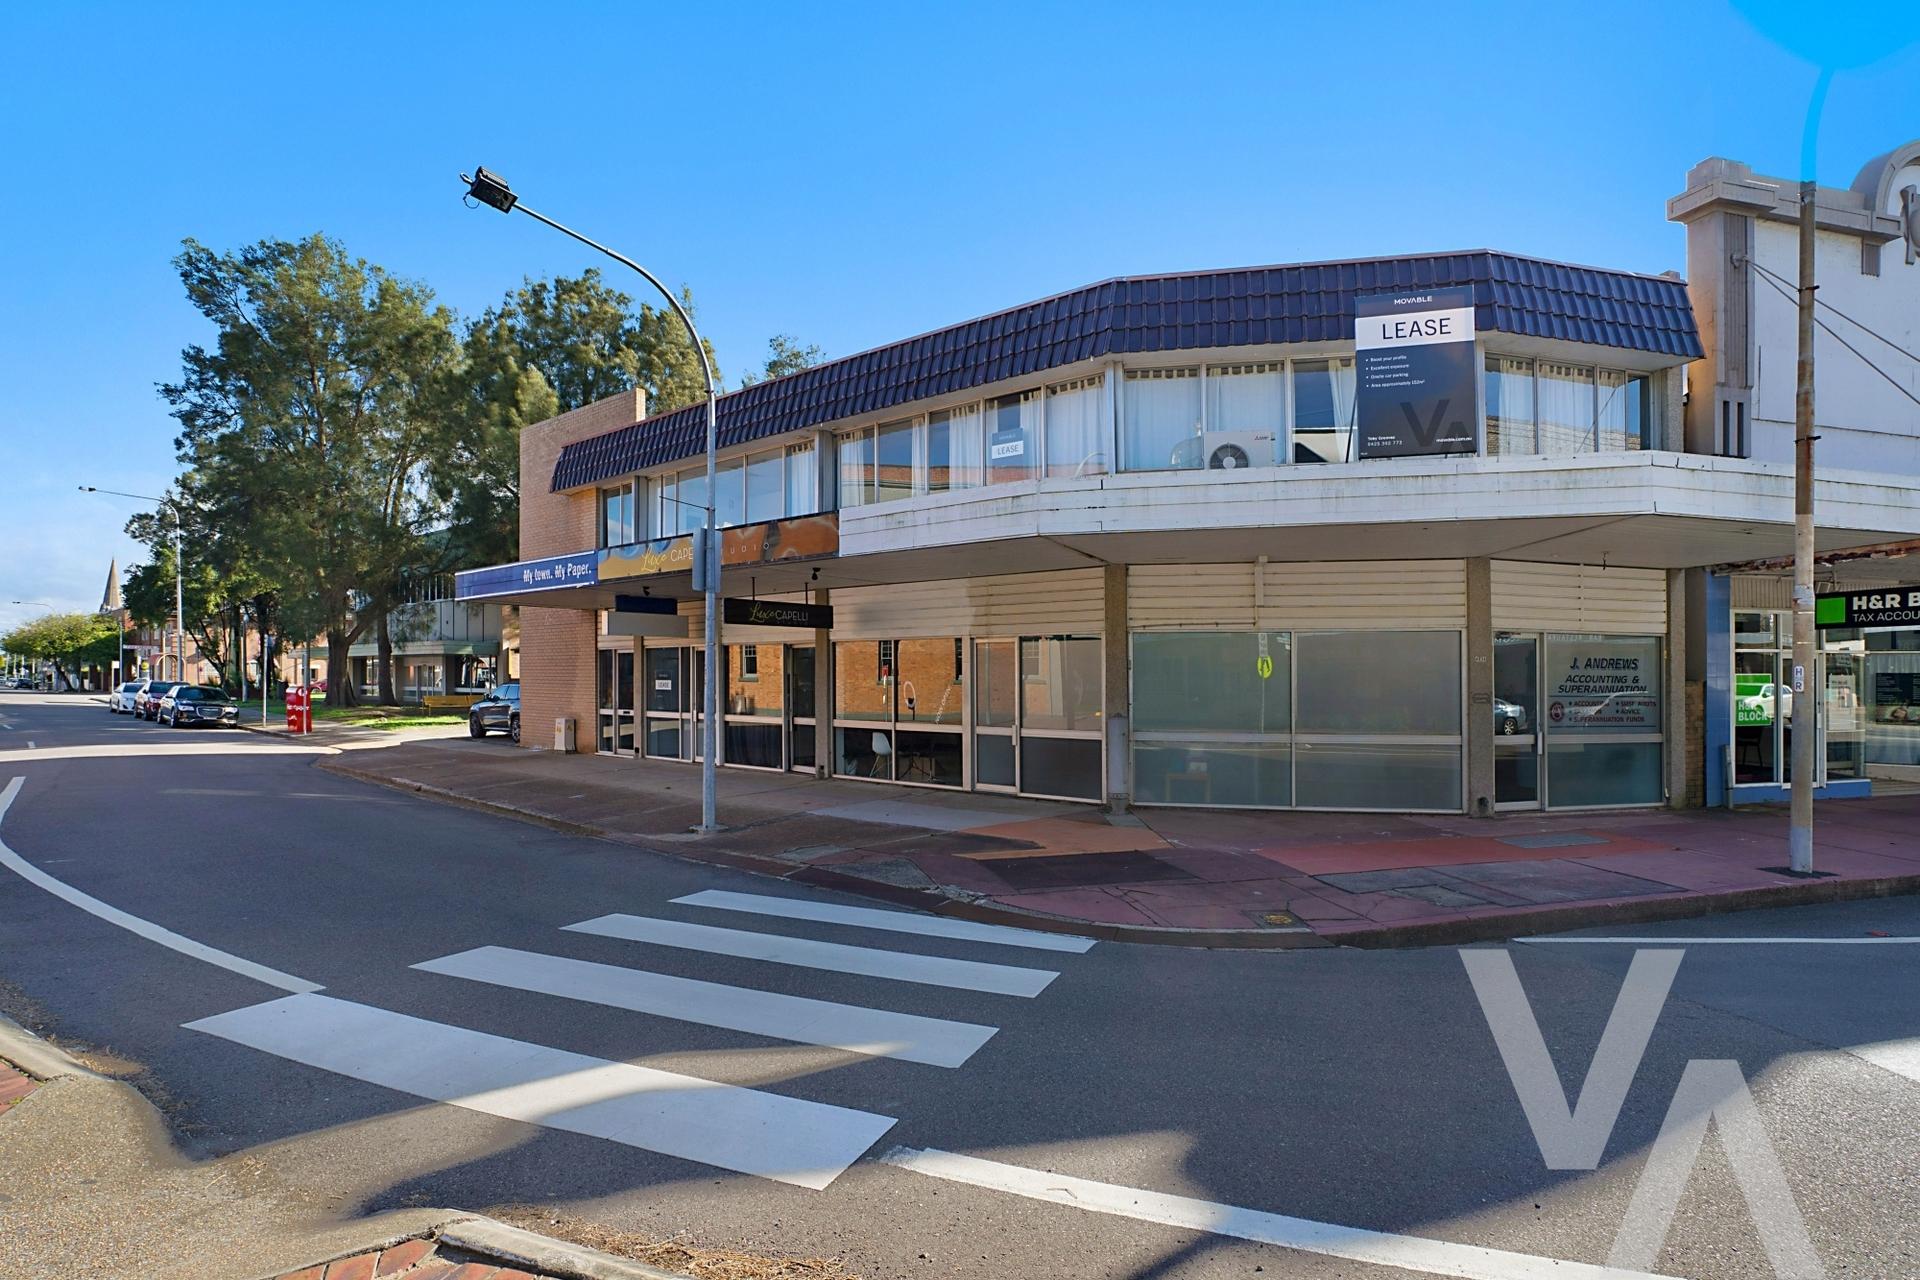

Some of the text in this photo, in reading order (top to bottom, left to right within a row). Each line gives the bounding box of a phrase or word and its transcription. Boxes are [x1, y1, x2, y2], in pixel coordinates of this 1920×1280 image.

[1394, 296, 1432, 305] MOVABLE
[1382, 317, 1452, 340] LEASE
[997, 443, 1020, 456] LEASE
[670, 547, 694, 562] CAPE
[523, 562, 592, 584] My town. My Paper.
[1852, 592, 1920, 610] H&R B
[775, 609, 809, 622] CAPELLI
[1852, 610, 1920, 623] TAX ACCOU
[1569, 657, 1640, 671] J. ANDREWS
[1565, 674, 1640, 684] ACCOUNTING &
[1557, 684, 1648, 694] SUPERANNUATION
[1738, 711, 1768, 721] BLOCK
